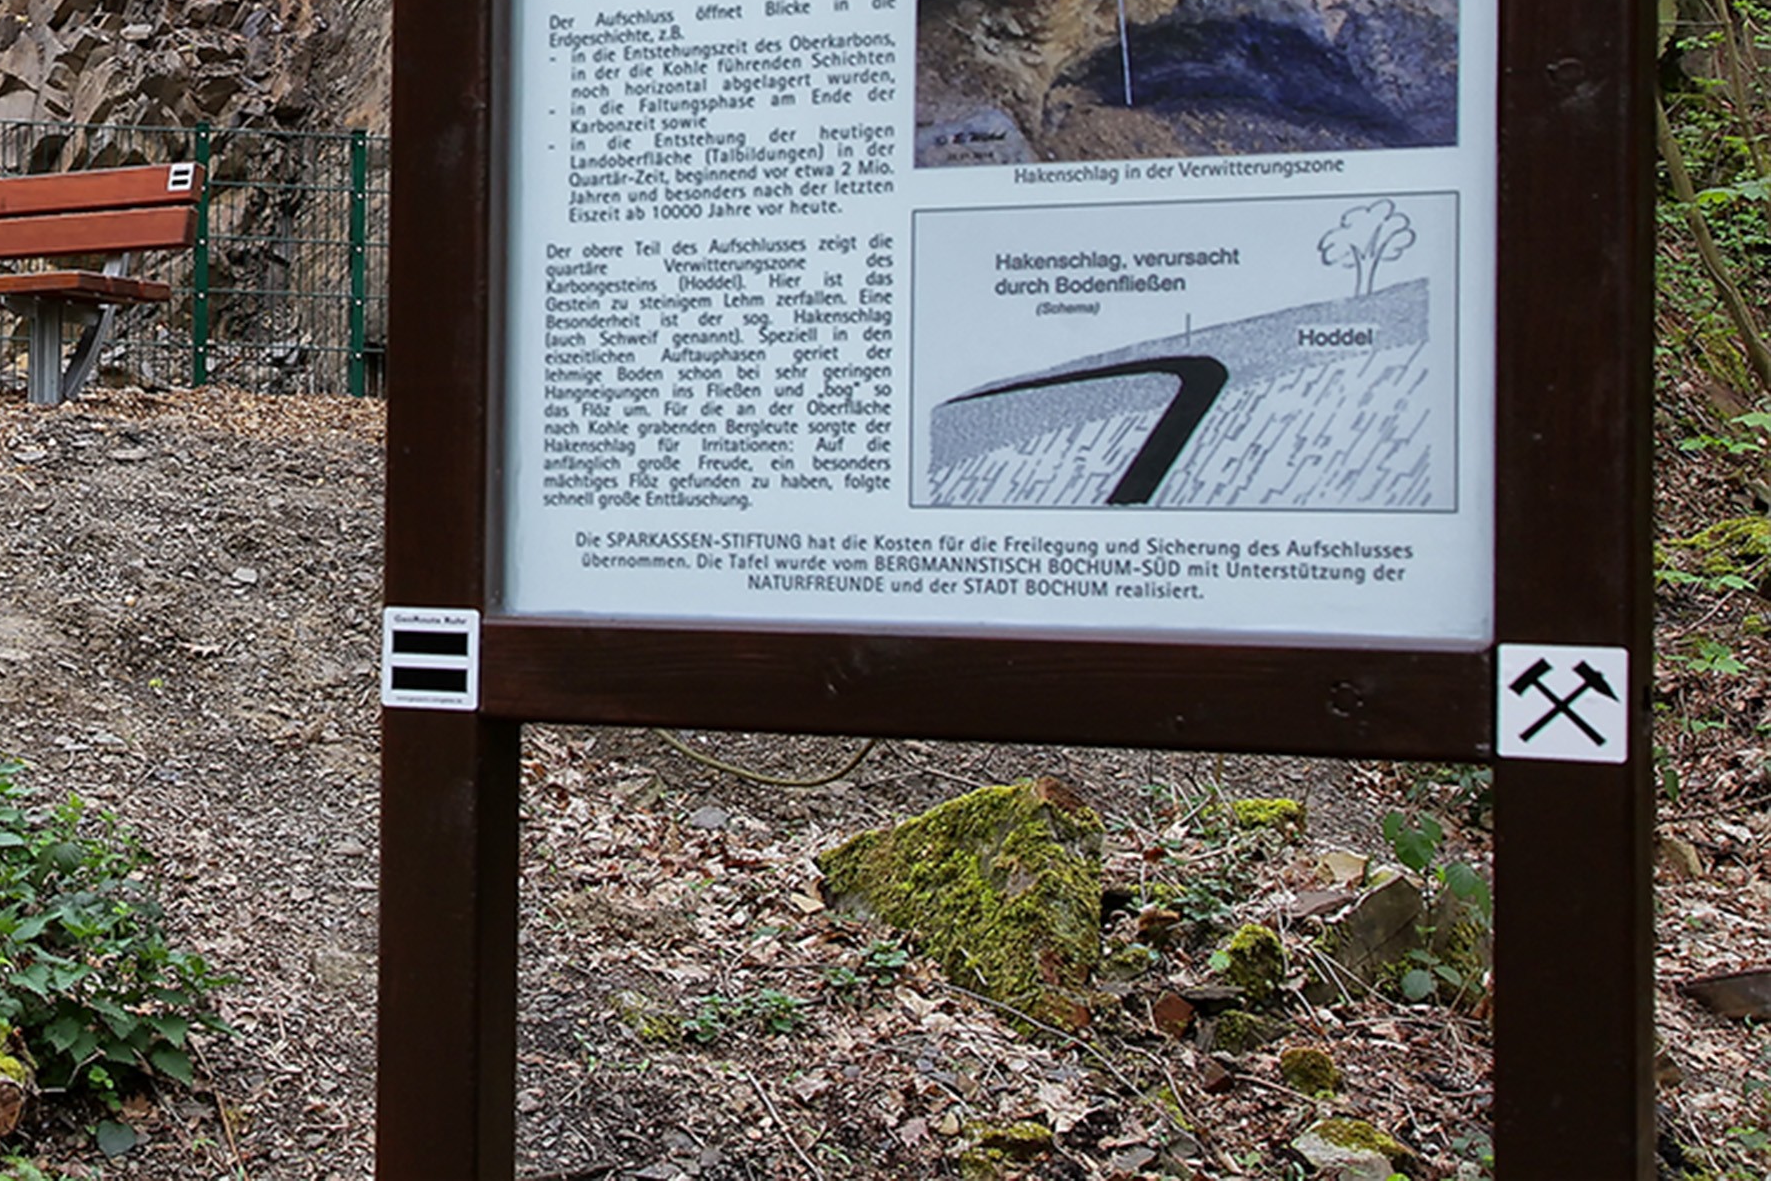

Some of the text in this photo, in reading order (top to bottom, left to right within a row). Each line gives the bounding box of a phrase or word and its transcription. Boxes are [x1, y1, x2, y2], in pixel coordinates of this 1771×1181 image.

[549, 14, 575, 30] Der
[594, 9, 675, 27] Aufschluss
[695, 3, 743, 21] öffnet
[764, 0, 811, 16] Blicke
[570, 45, 896, 81] in der die Kohle führenden Schichten
[1014, 159, 1345, 186] Hakenschlag in der Verwitterungszone
[568, 179, 894, 205] Jahren und besonders nach der letzten
[568, 195, 843, 222] Eiszeit ab 10000 Jahre vor heute.
[546, 233, 894, 259] Der obere Teil des Aufschlusses zeigt die
[995, 247, 1240, 273] Hakenschlag, verursacht
[994, 273, 1186, 296] durch Bodenfließen
[544, 287, 893, 313] Gestein zu steinigem Lehm zerfallen. Eine
[1035, 301, 1101, 317] (Schema)
[1297, 327, 1374, 348] Hoddel
[543, 433, 892, 457] Hakenschlag für Irritationen: Auf die
[542, 488, 753, 510] schnell große Enttäuschung.
[575, 531, 1414, 562] Die SPARKASSEN-STIFTUNG hat die Kosten für die Freilegung und Sicherung des Aufschlusses
[581, 552, 1406, 585] übernommen. Die Tafel wurde vom BERGMANNSTISCH BOCHUM-SÜD mit Unterstützung der
[747, 573, 1204, 600] NATURFREUNDE und der STADT BOCHUM realisiert.
